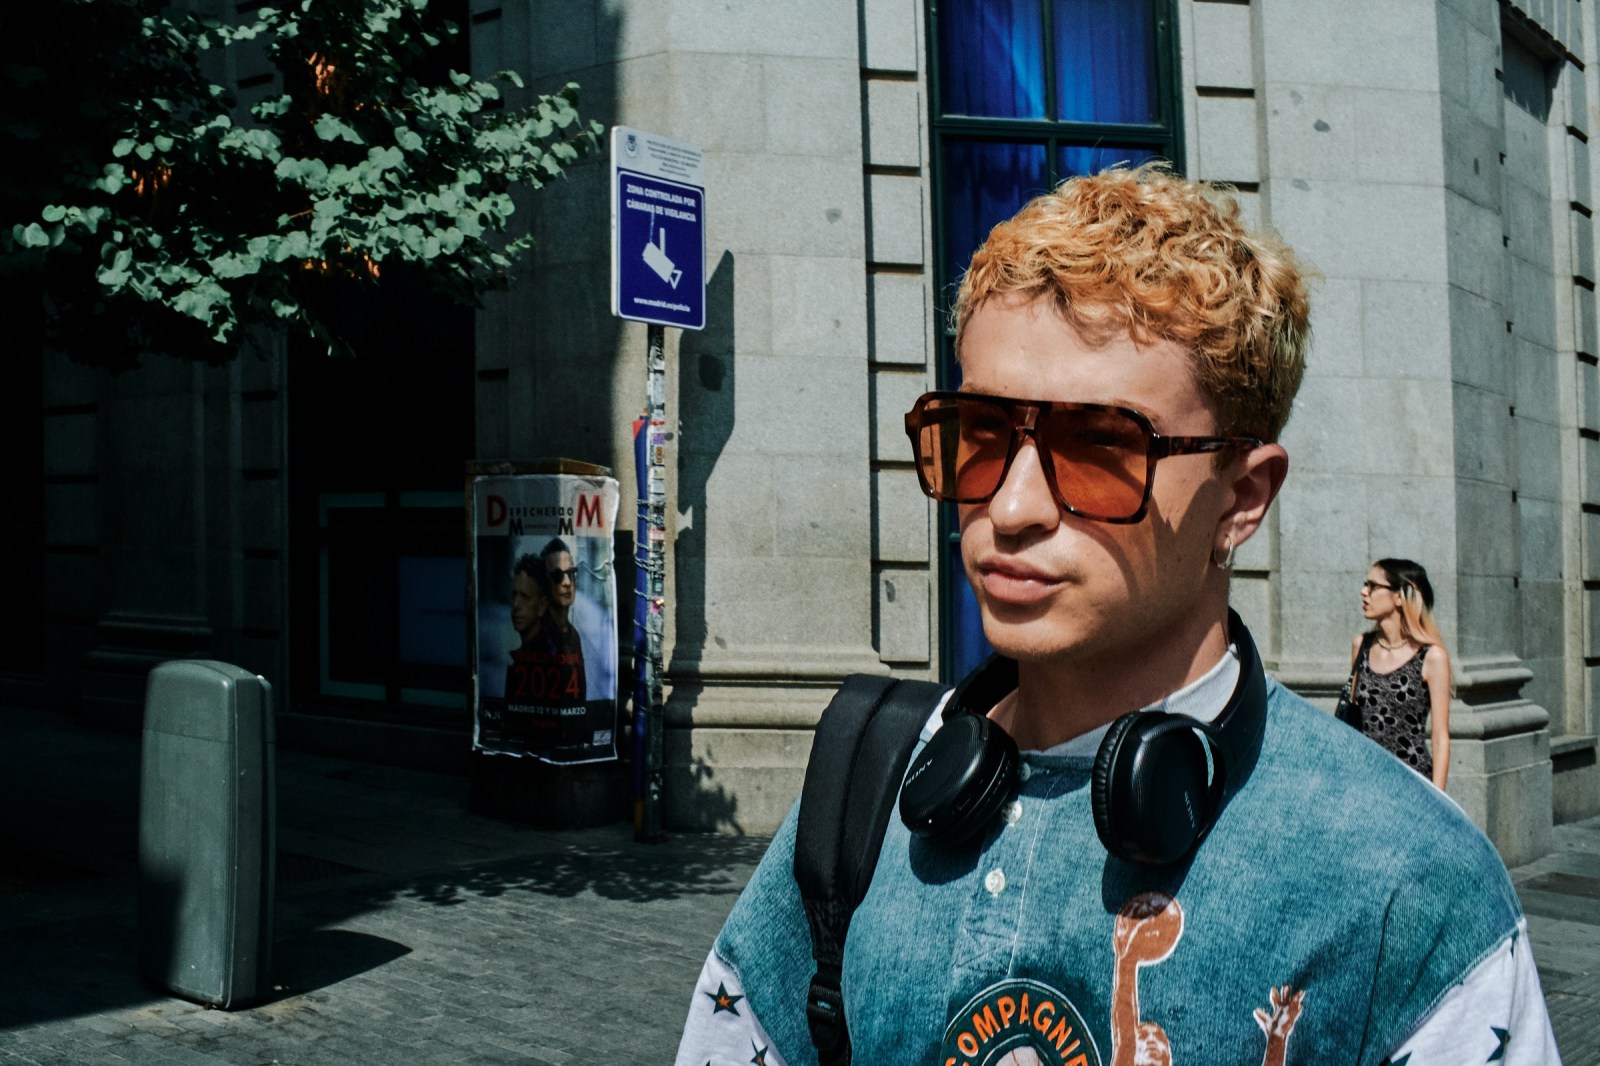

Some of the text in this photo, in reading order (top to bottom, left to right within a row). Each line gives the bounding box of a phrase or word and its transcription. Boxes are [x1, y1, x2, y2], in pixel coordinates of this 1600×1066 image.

[627, 183, 696, 208] ZONA CONTROLADA POR
[655, 205, 664, 215] DE
[664, 207, 697, 222] VIGILANCIA
[515, 664, 580, 699] 2024
[508, 704, 535, 715] MADRID
[560, 706, 587, 717] MARZO
[905, 758, 933, 788] SONY
